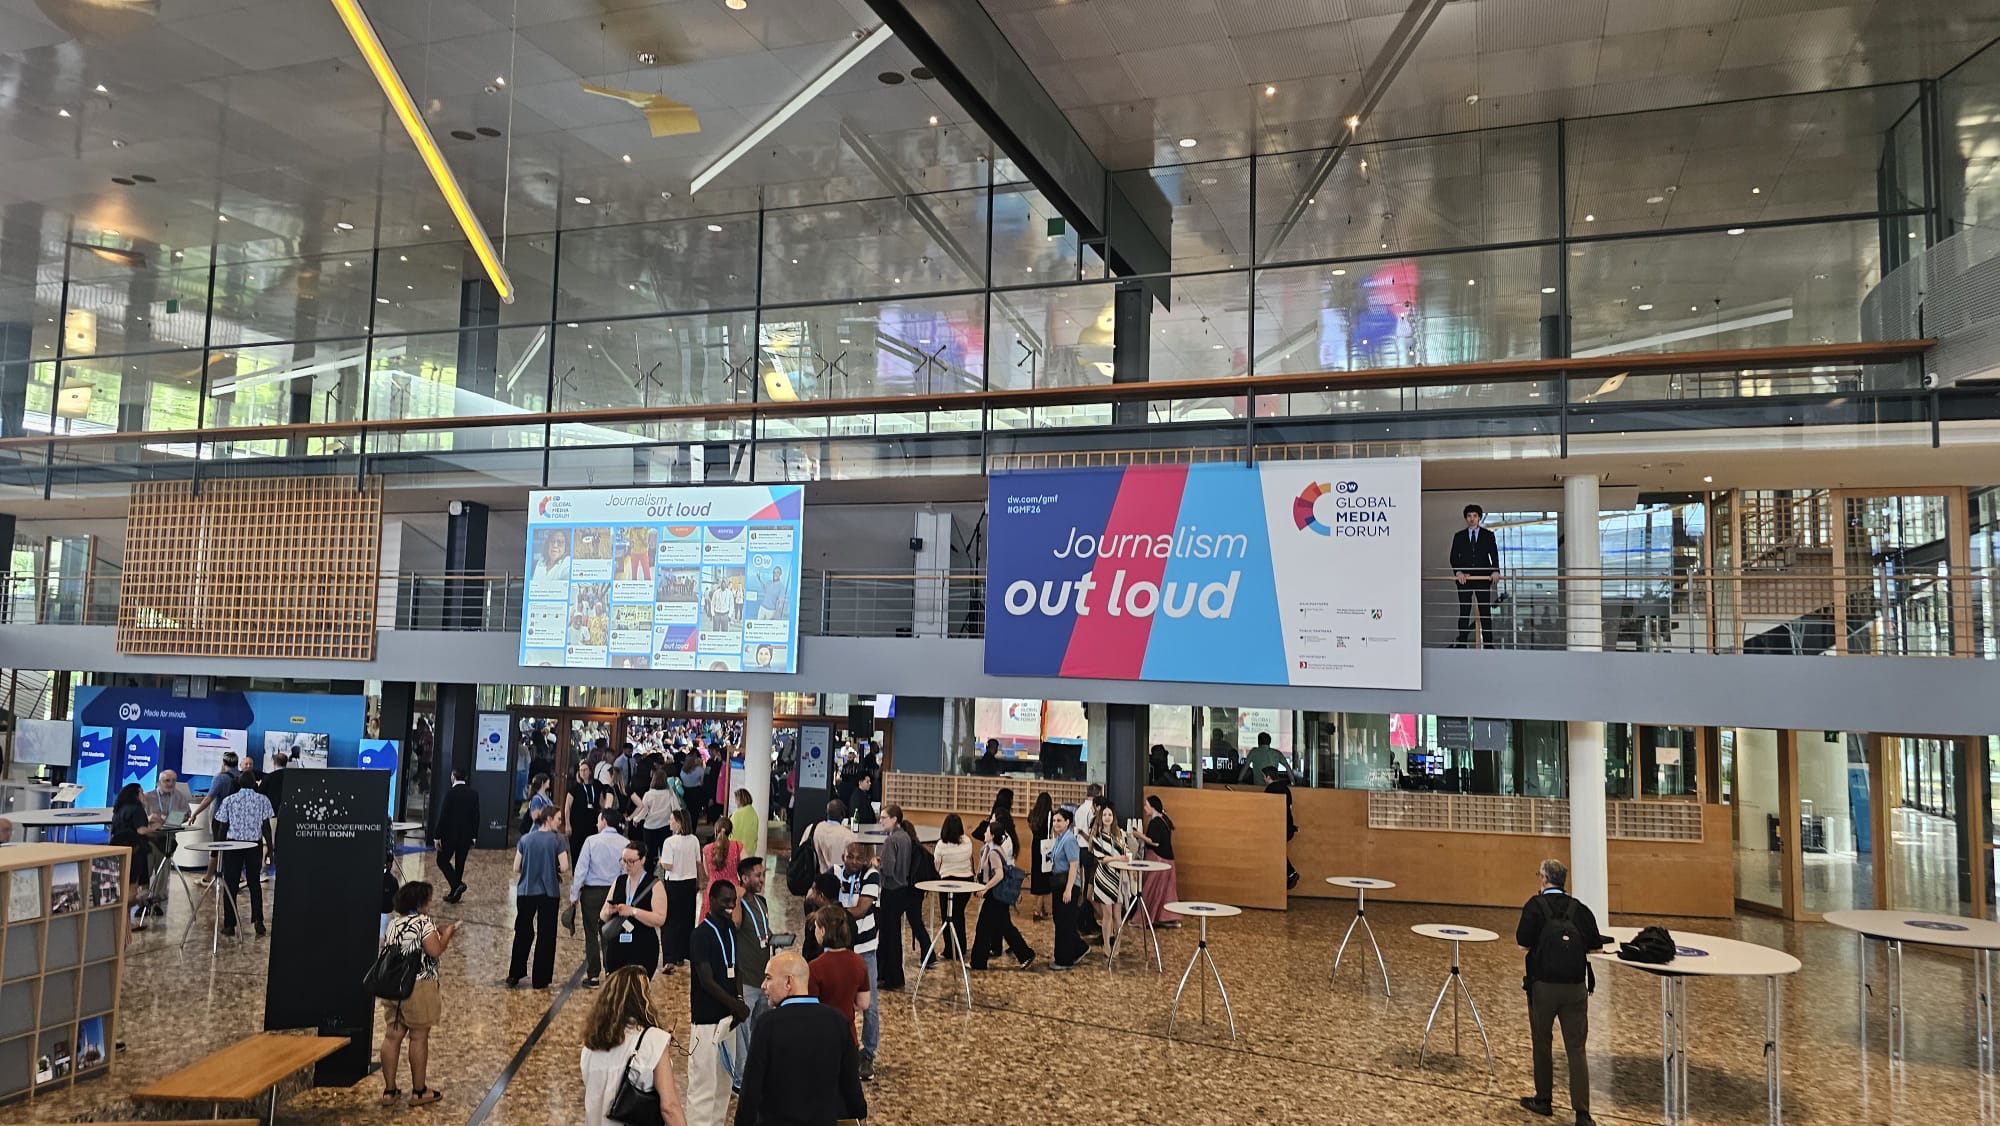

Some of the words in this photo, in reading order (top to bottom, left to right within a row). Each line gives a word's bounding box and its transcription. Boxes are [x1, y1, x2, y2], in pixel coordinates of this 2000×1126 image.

[605, 492, 668, 506] Journalism
[1007, 494, 1059, 504] dw.com/gmf
[1336, 496, 1397, 509] GLOBAL
[647, 502, 674, 517] out
[676, 501, 712, 517] loud
[1007, 505, 1041, 514] #GMF26
[1336, 511, 1388, 523] MEDIA
[1336, 525, 1390, 537] FORUM
[1053, 526, 1248, 559] Journalism
[1004, 570, 1097, 616] out
[1107, 569, 1241, 619] loud
[143, 708, 160, 718] Made
[160, 709, 169, 718] for
[296, 823, 326, 831] WORLD
[327, 823, 381, 831] CONFERENCE
[296, 830, 328, 838] CENTER
[329, 830, 356, 838] BONN
